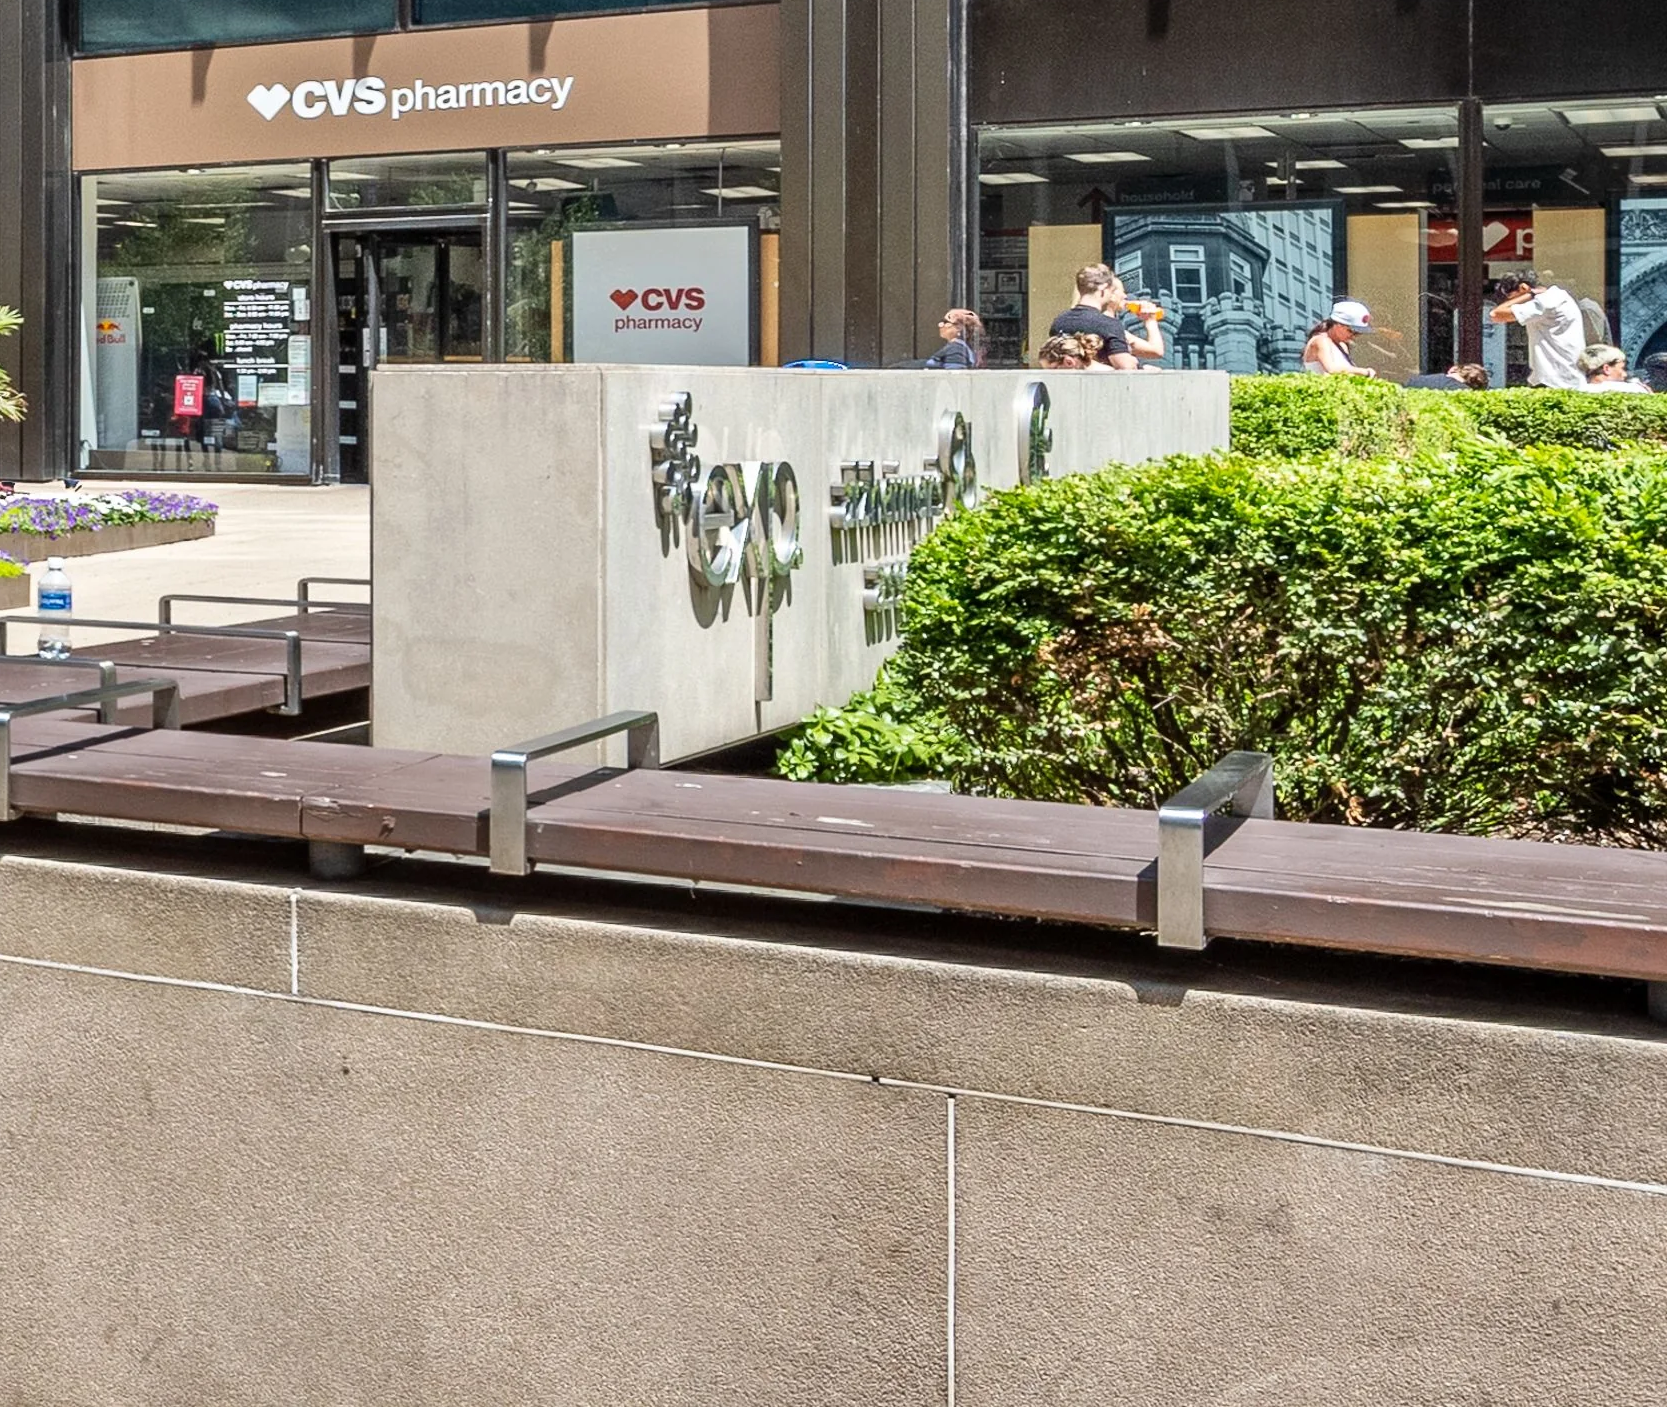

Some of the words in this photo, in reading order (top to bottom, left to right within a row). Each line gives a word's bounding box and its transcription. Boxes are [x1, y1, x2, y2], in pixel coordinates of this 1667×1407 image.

[292, 77, 387, 119] CVS
[392, 76, 574, 120] pharmacy
[1505, 179, 1542, 190] care
[1121, 189, 1196, 203] household
[234, 280, 253, 290] CVS
[641, 287, 705, 311] CVS
[615, 315, 703, 333] pharmacy
